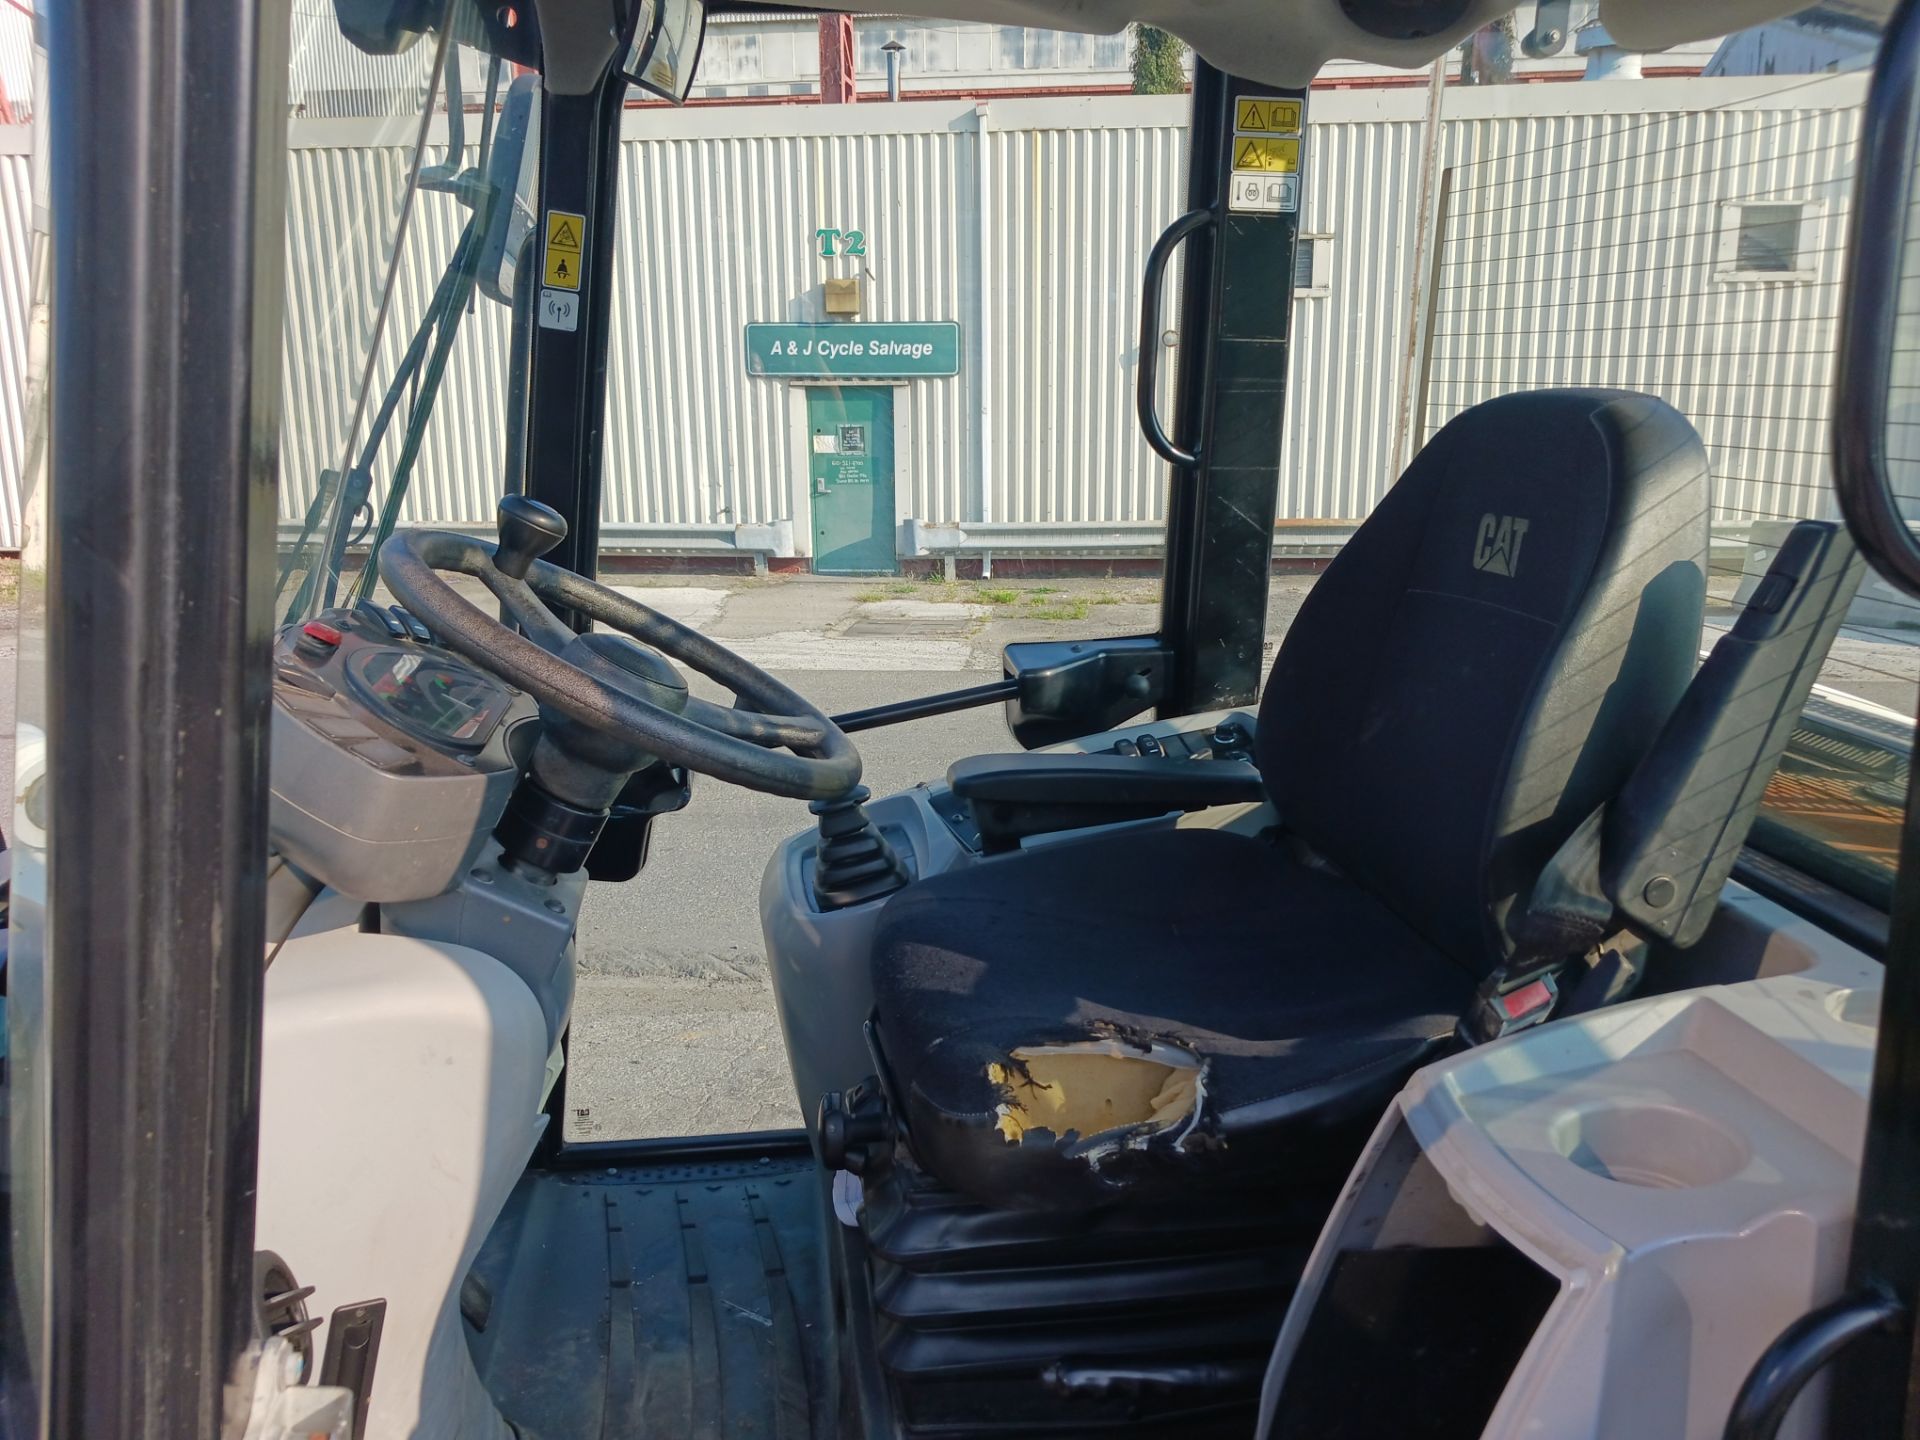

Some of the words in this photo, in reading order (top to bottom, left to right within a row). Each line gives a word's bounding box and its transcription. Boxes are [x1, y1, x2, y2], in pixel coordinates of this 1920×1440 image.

[815, 228, 866, 257] T2
[770, 340, 783, 356] A
[786, 340, 798, 356] &
[803, 340, 813, 356] J
[817, 340, 864, 359] Cycle
[868, 340, 933, 359] Salvage
[1473, 513, 1529, 578] CAT
